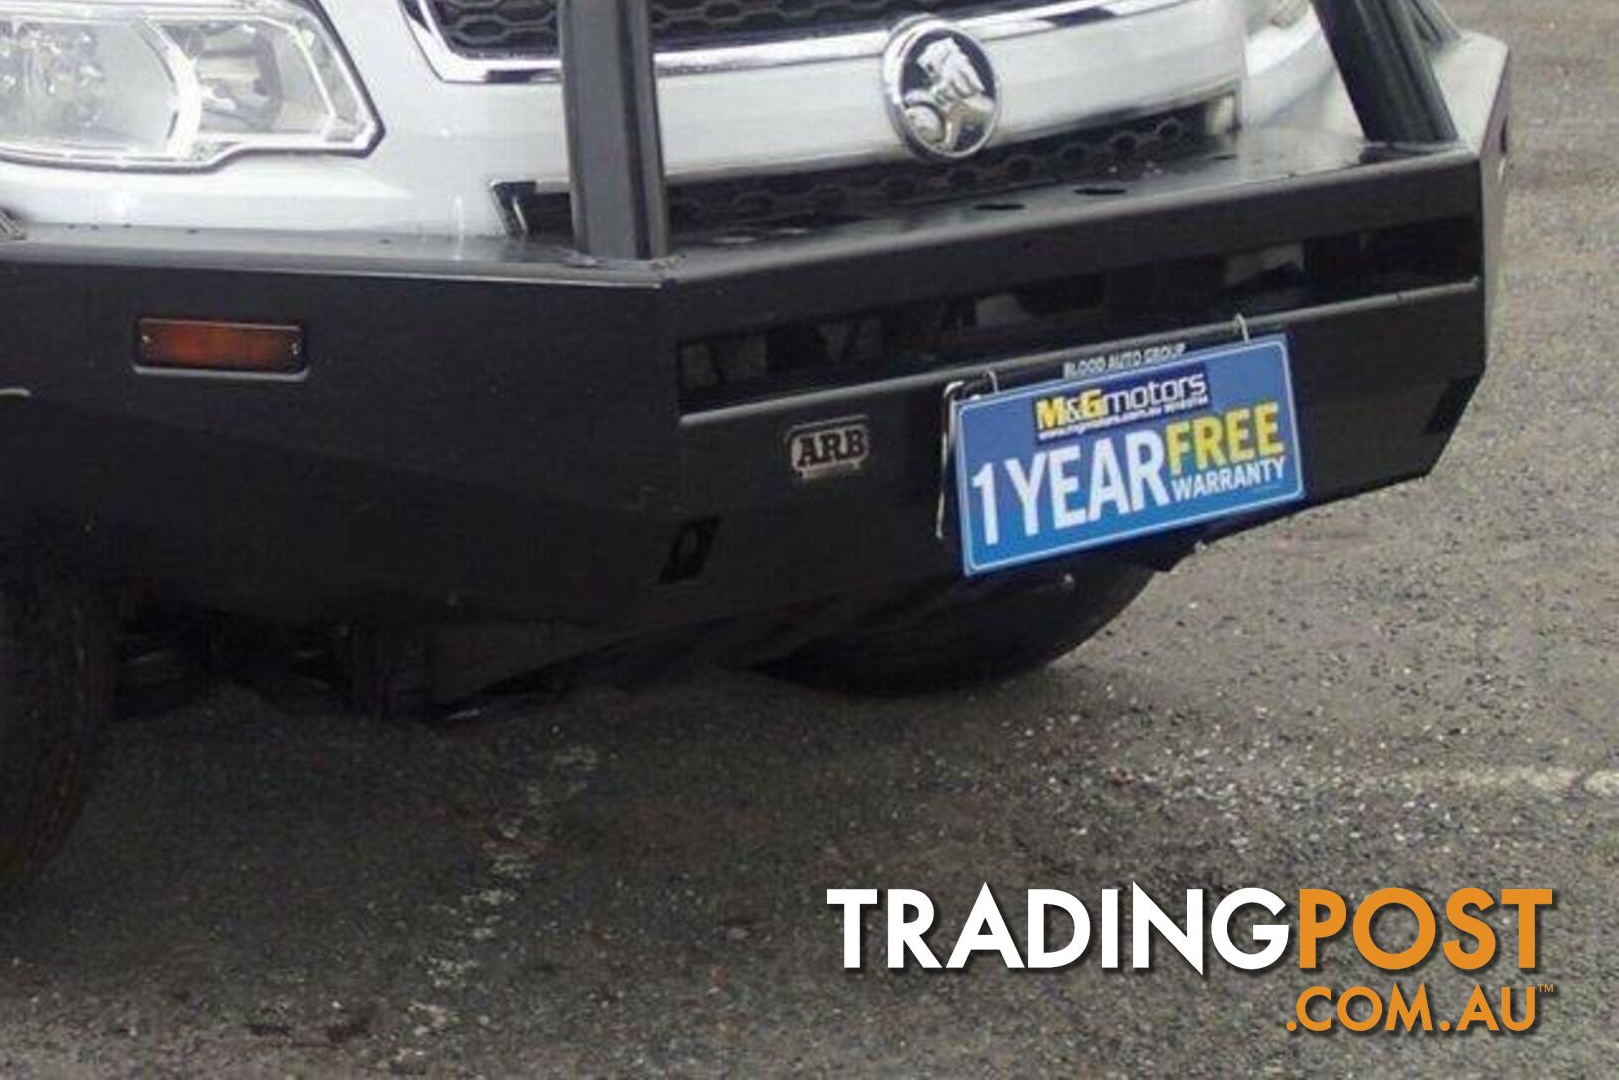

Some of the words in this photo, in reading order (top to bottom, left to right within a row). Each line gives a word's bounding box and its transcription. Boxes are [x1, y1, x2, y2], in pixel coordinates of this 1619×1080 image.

[1062, 358, 1106, 380] BLOOD
[1107, 350, 1141, 372] AUTO
[1143, 342, 1186, 363] GROUP
[792, 424, 868, 472] ARB
[1165, 401, 1285, 477] FREE
[1170, 454, 1287, 503] WARRANTY
